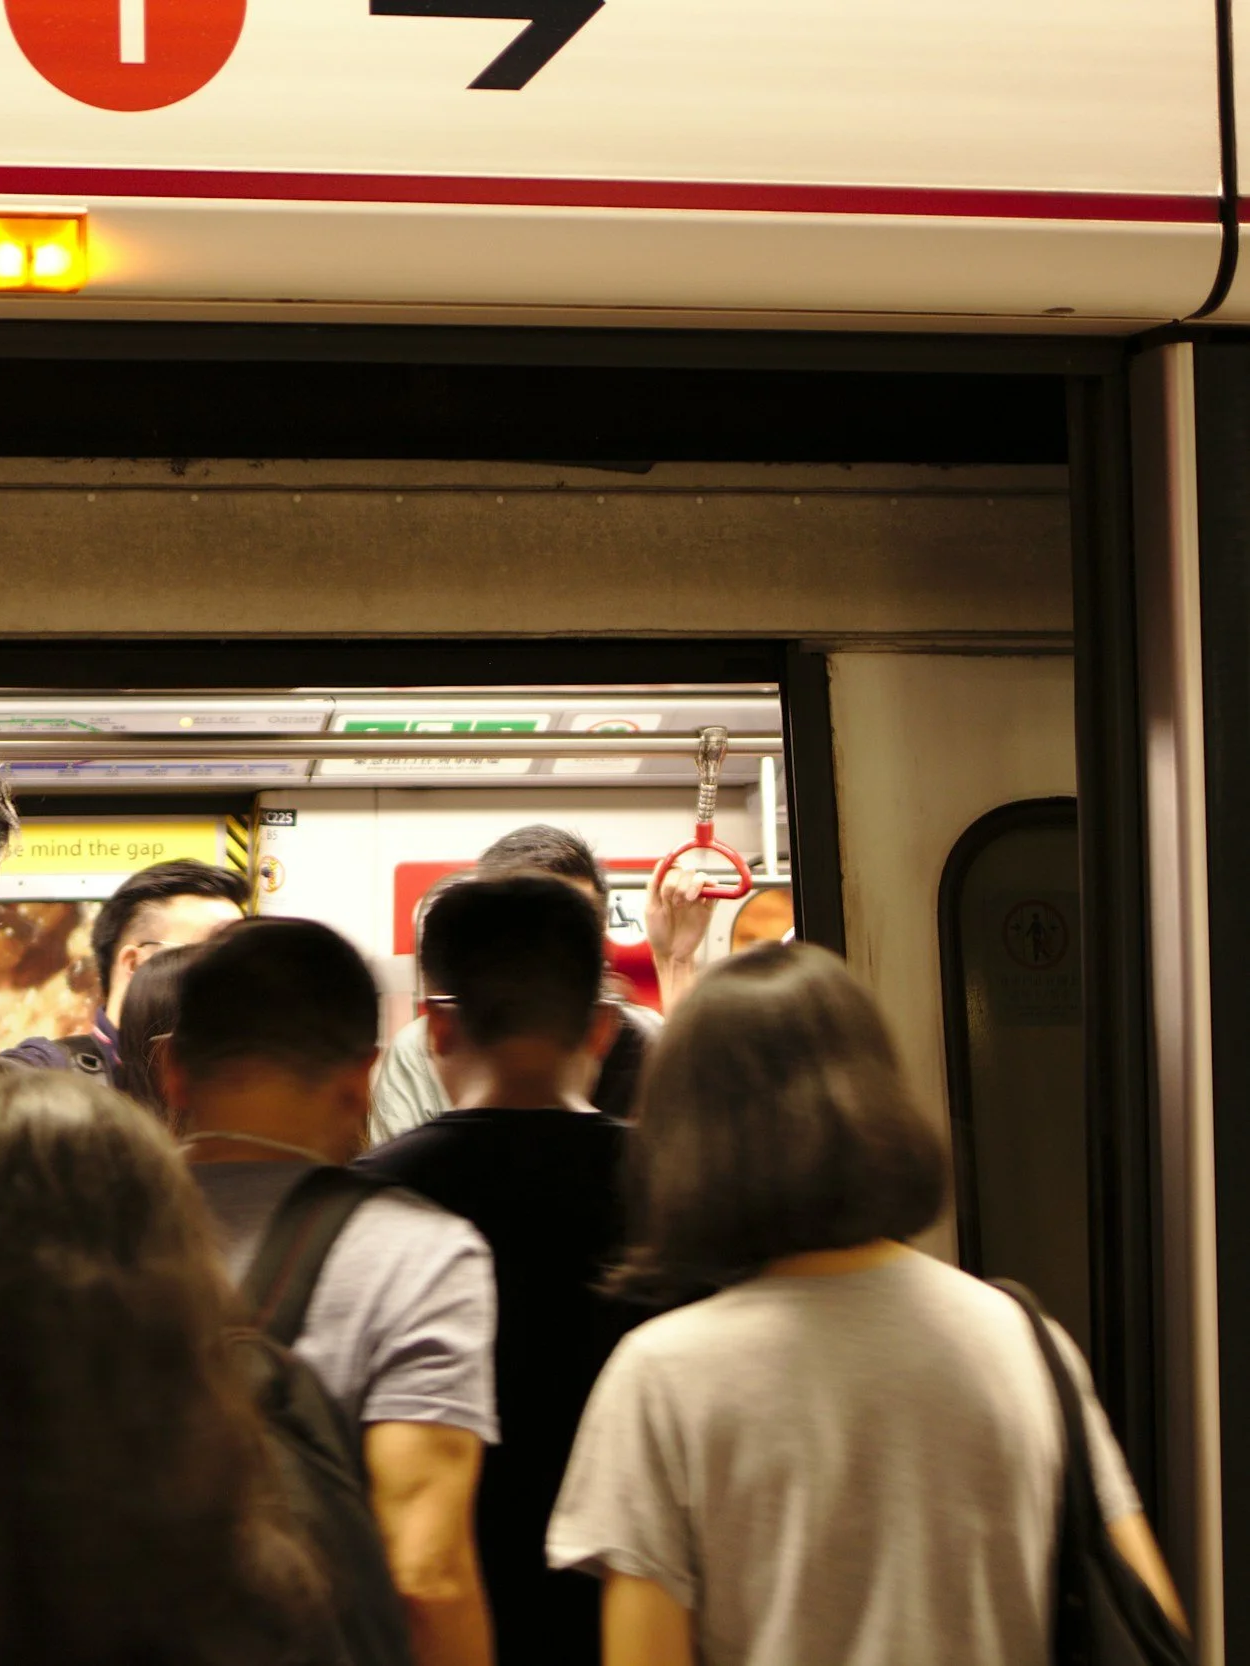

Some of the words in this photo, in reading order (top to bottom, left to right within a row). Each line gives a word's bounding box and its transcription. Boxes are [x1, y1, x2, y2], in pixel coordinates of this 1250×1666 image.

[31, 839, 82, 857] mind
[89, 839, 121, 856] the
[126, 841, 164, 860] gap
